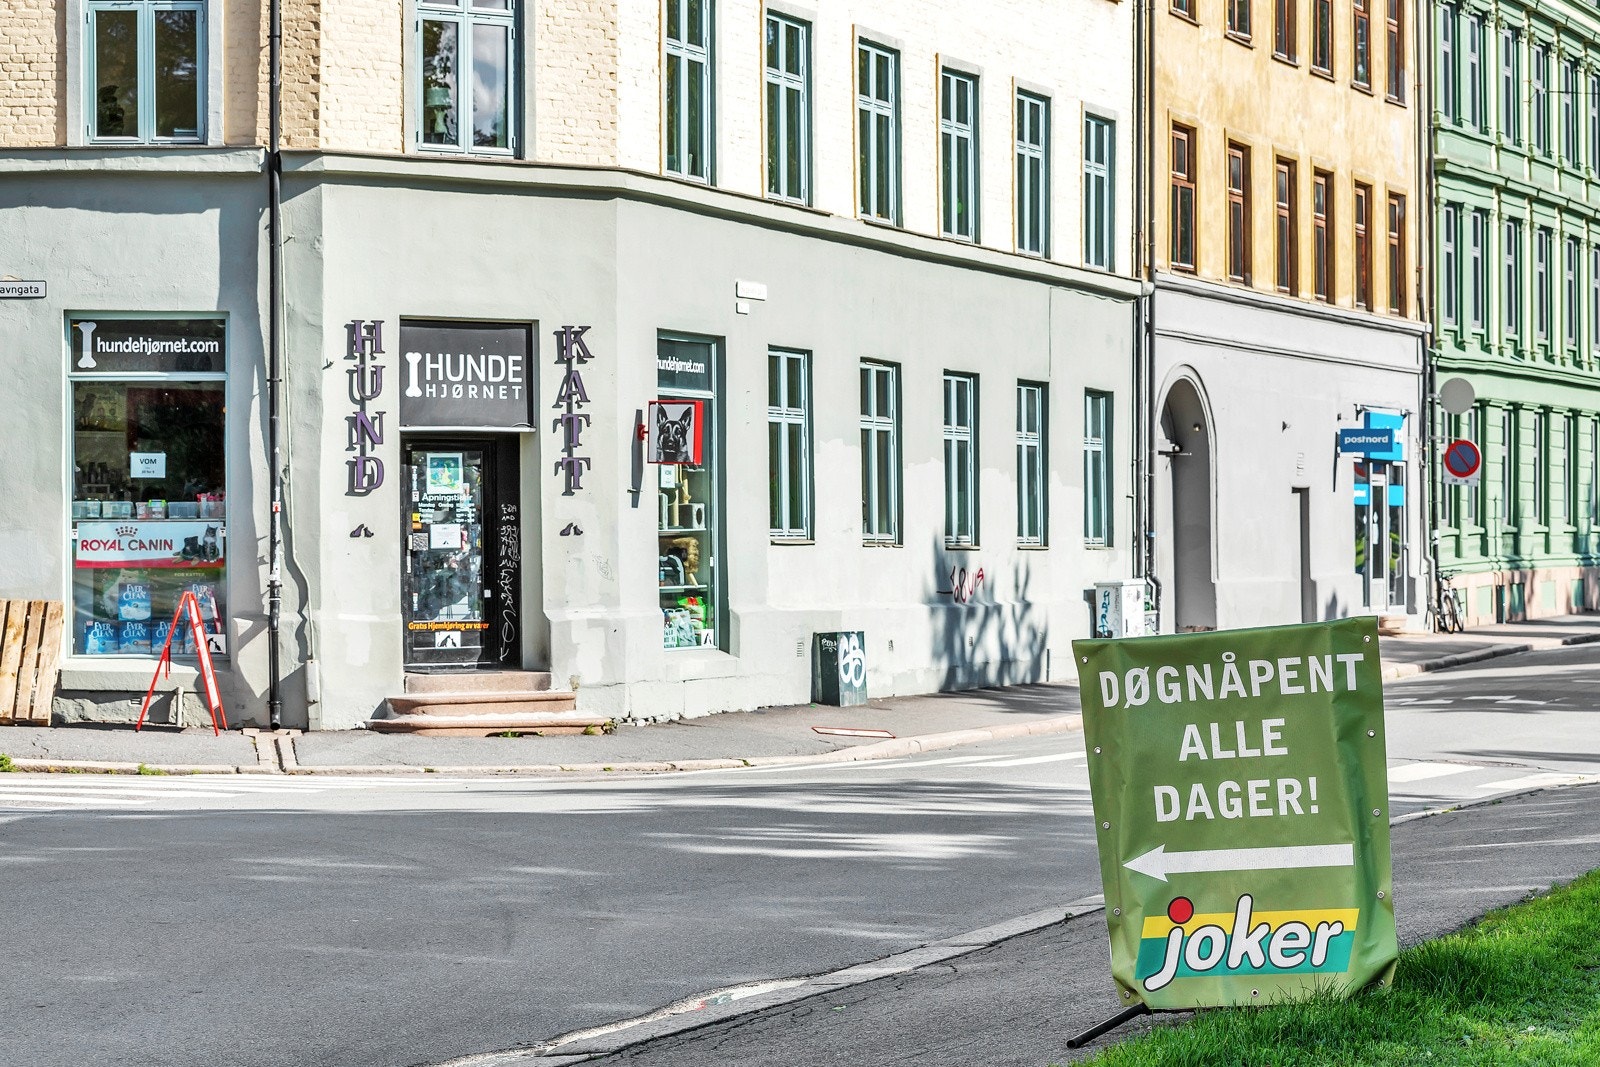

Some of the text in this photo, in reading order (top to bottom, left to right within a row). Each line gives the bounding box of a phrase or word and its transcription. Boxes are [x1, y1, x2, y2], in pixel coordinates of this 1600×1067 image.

[0, 285, 40, 296] avngata
[96, 337, 219, 355] hundehjørnet.com
[426, 353, 523, 383] HUNDE
[426, 384, 523, 400] HJØRNET
[1344, 434, 1389, 445] postnord
[80, 539, 173, 551] ROYAL CANIN
[126, 584, 143, 593] EVER
[122, 590, 146, 600] CLEAN
[94, 621, 111, 631] EVER
[126, 621, 143, 631] EVER
[408, 622, 427, 630] Gratis
[428, 622, 465, 631] Hjemkjøring
[90, 629, 114, 638] CLEAN
[122, 628, 146, 638] CLEAN
[1099, 651, 1364, 709] DØGNÅPENT
[1178, 718, 1289, 762] ALLE
[1153, 776, 1320, 823] DAGER!
[1142, 893, 1345, 993] joker
